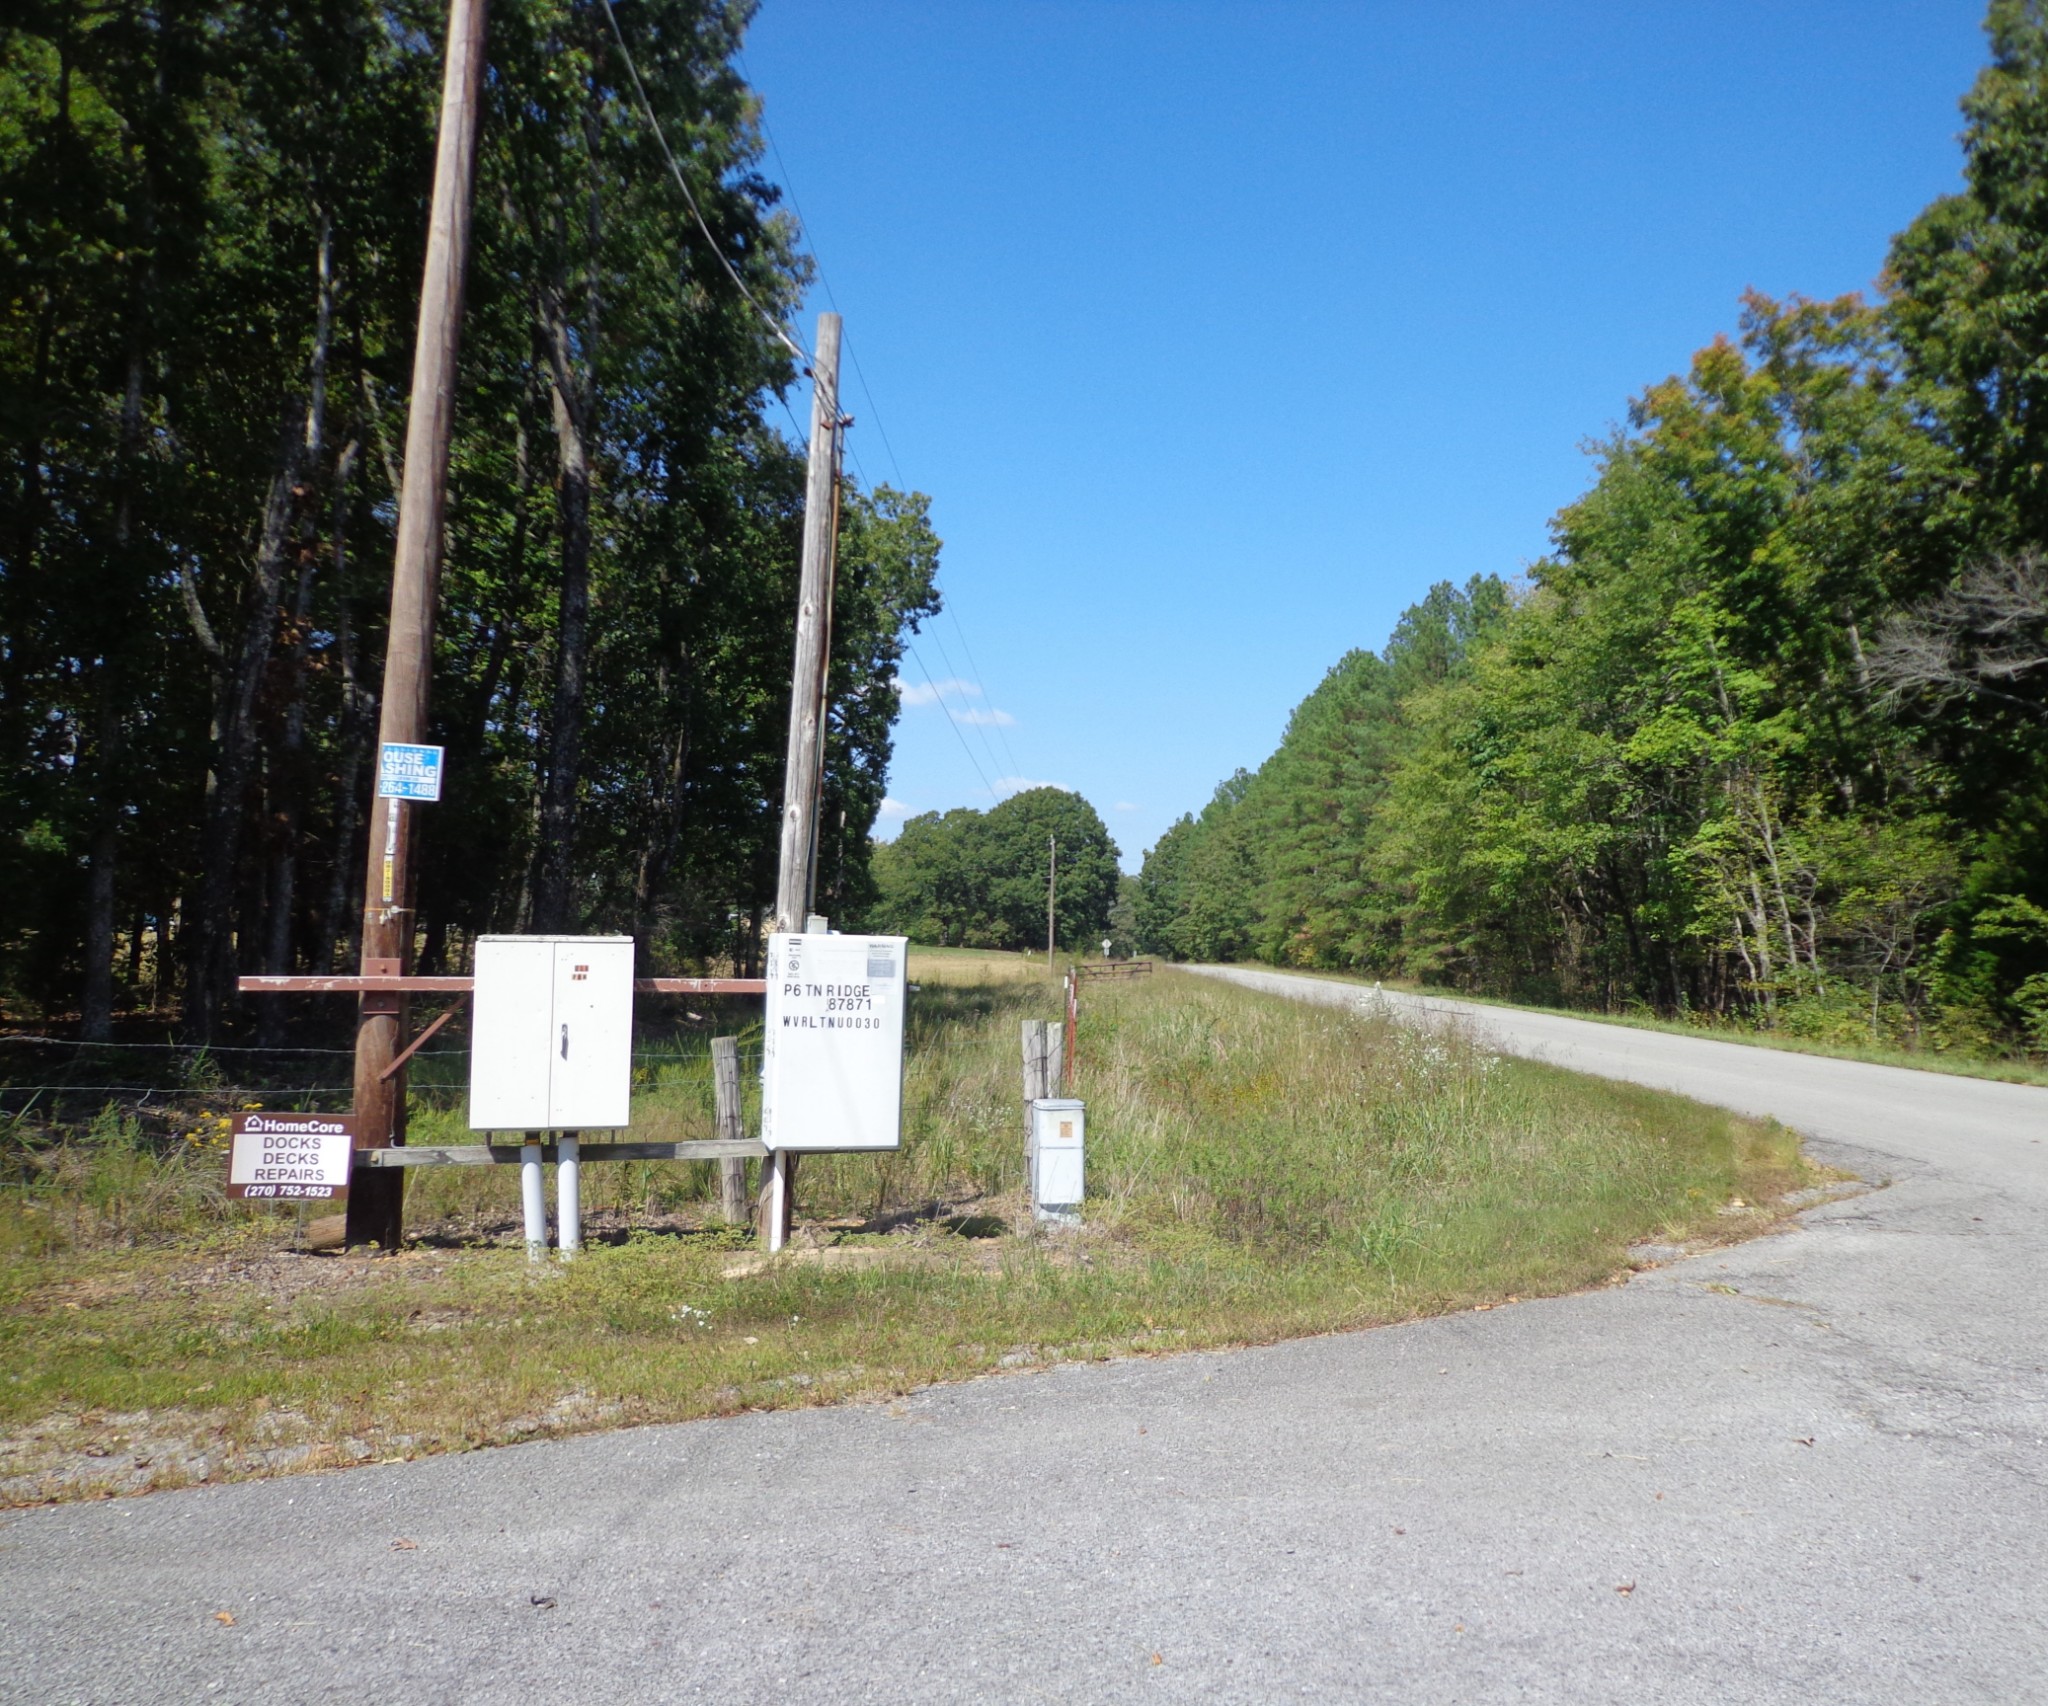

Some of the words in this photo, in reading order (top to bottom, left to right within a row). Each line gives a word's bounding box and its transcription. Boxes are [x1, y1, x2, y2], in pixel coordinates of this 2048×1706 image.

[805, 983, 822, 997] TN
[826, 984, 871, 998] RIDGE
[828, 997, 872, 1011] 87871
[264, 1120, 344, 1134] HomeCore
[263, 1136, 321, 1150] DOCKS
[263, 1152, 319, 1165] DECKS
[254, 1168, 325, 1181] REPAIRS
[244, 1184, 276, 1198] (270)
[279, 1185, 333, 1197] 752-1523
